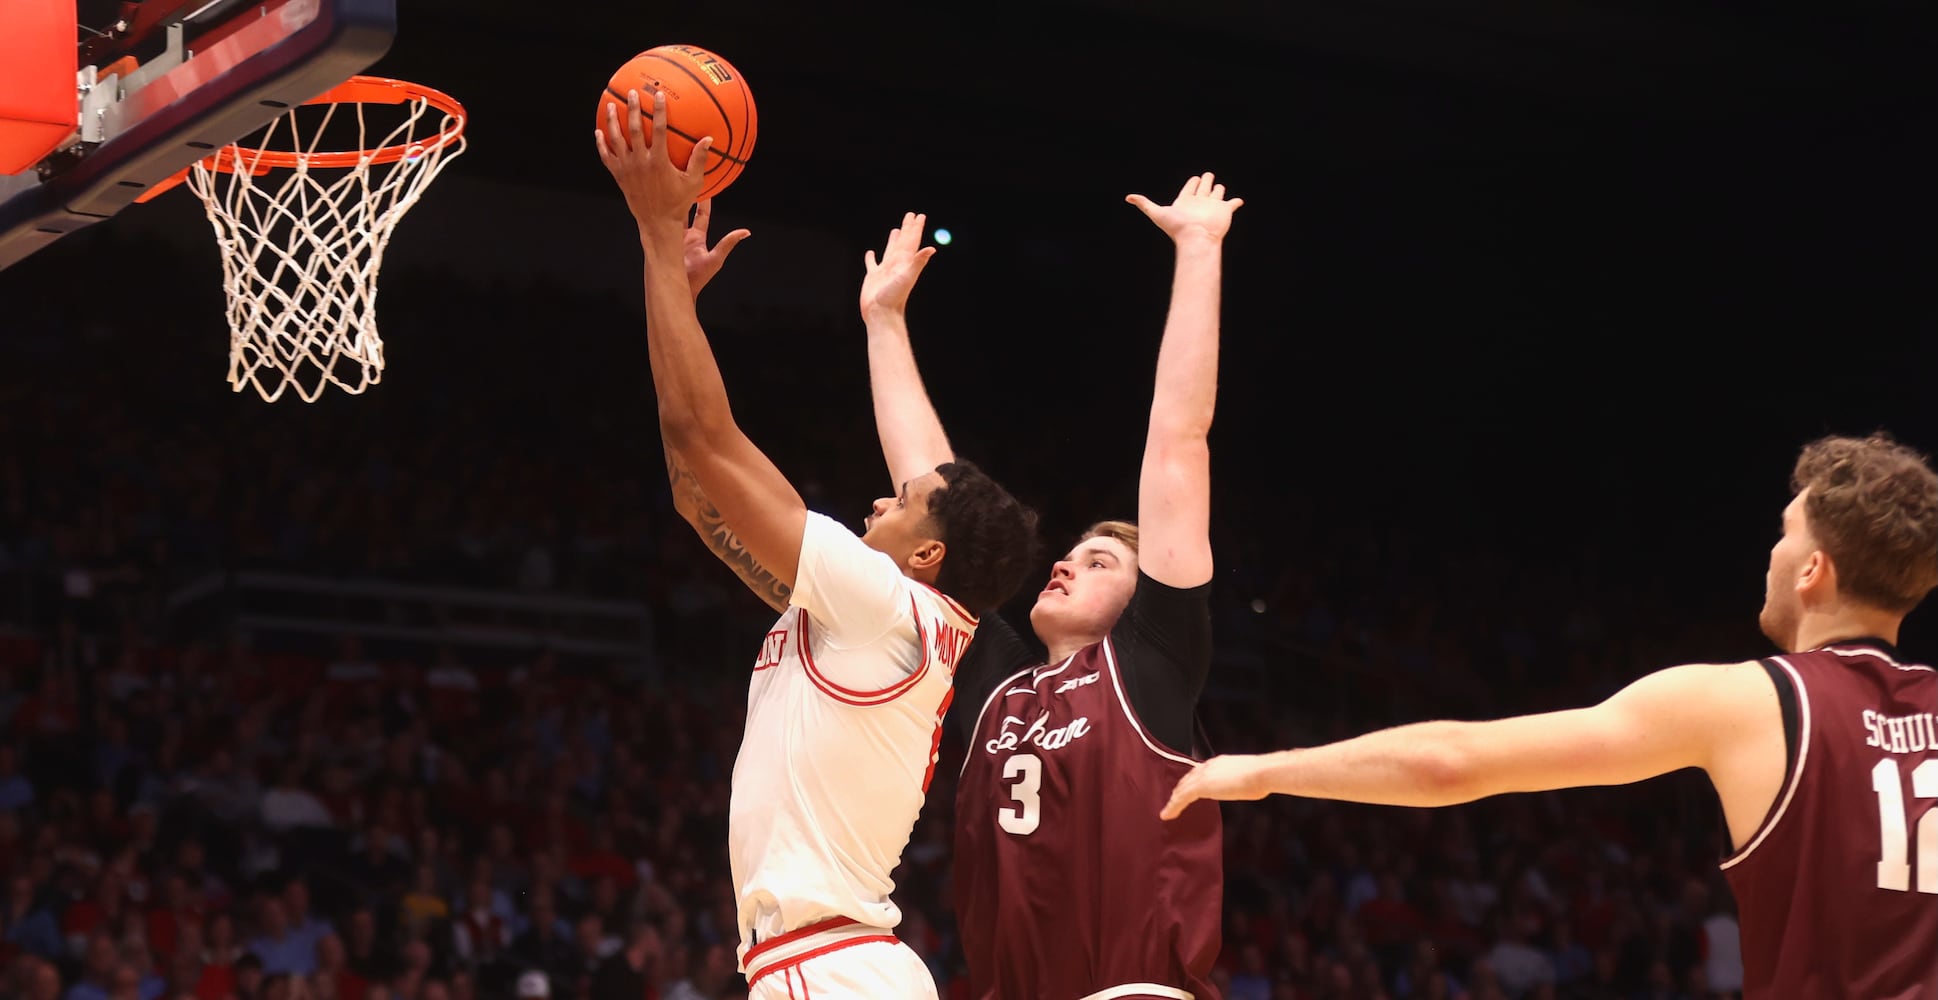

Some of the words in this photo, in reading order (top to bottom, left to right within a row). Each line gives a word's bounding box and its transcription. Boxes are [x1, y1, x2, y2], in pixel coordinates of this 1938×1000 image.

[673, 46, 732, 83] ELIT
[1862, 709, 1938, 754] SCHUL
[998, 753, 1042, 836] 3
[1872, 757, 1938, 895] 12
